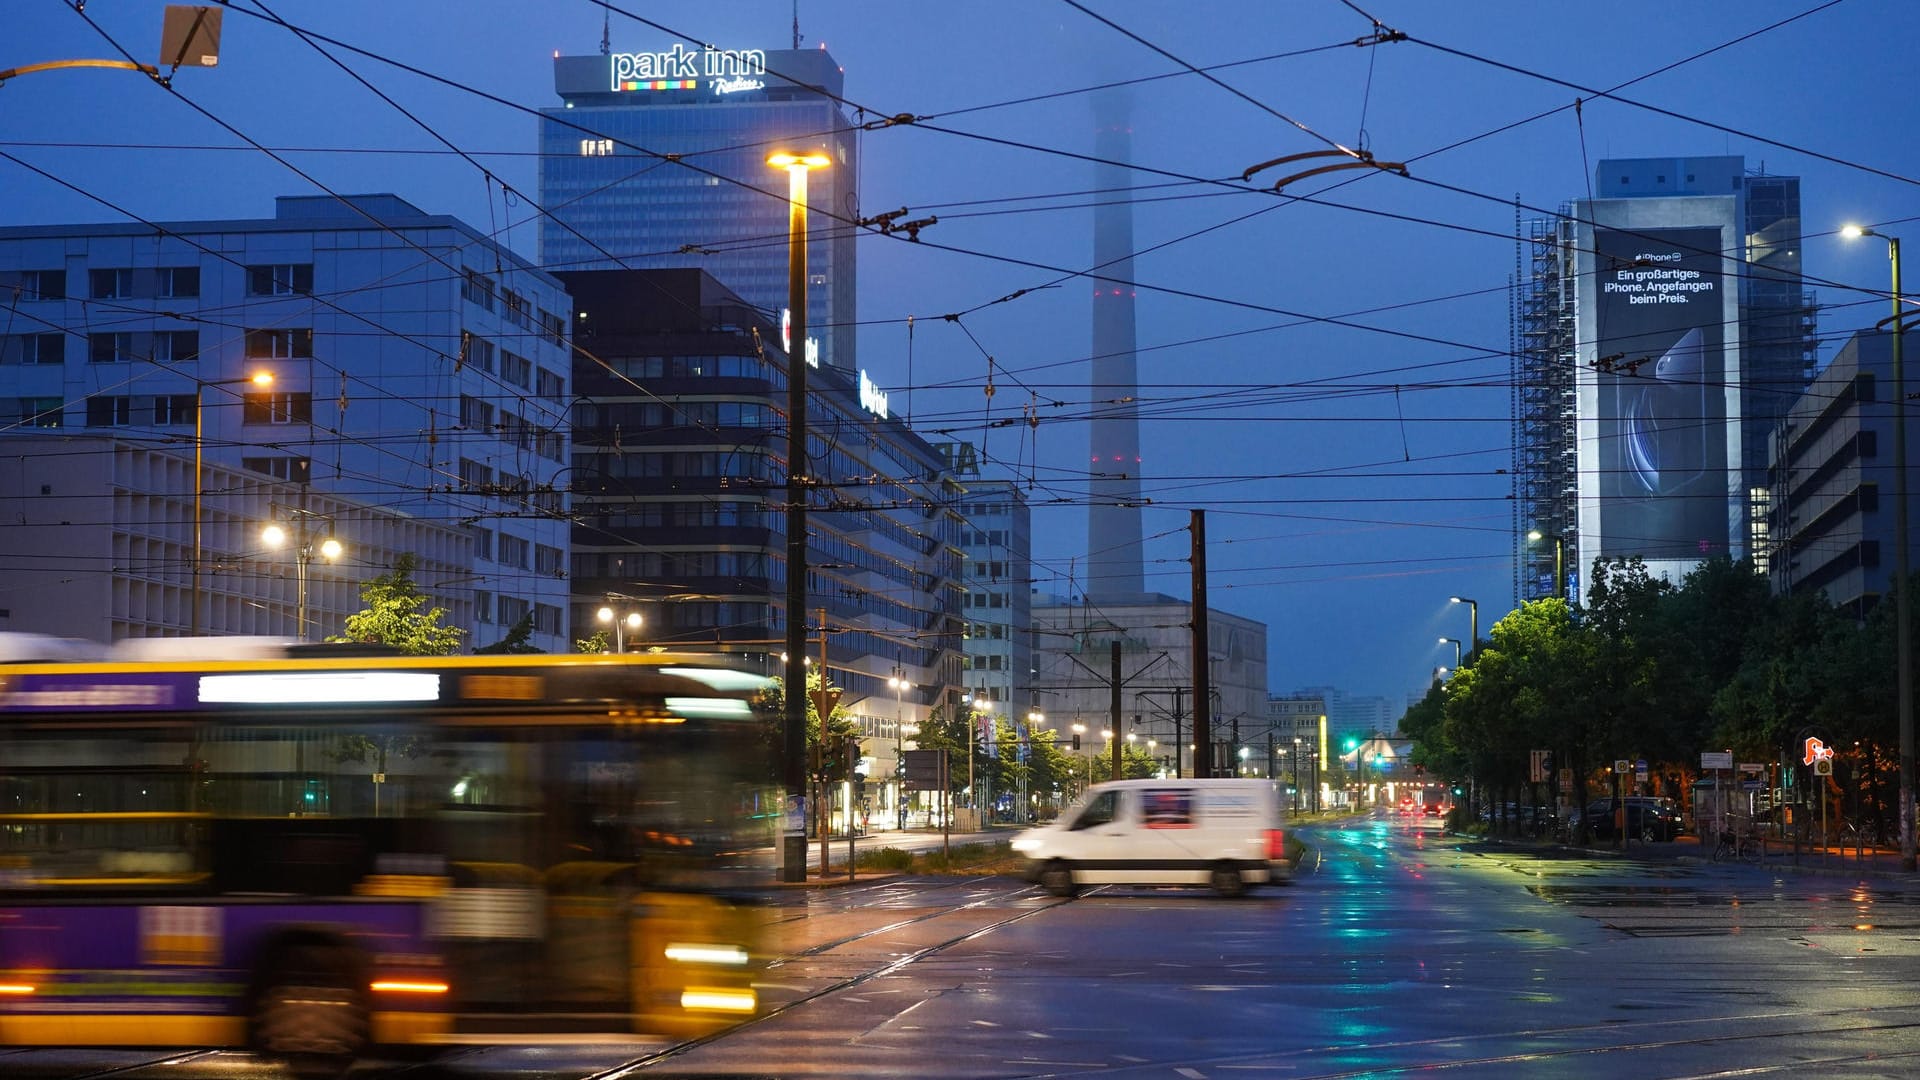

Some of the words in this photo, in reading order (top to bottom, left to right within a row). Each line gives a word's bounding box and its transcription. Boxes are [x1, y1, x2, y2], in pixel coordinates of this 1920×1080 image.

[611, 43, 698, 92] park
[705, 43, 766, 76] inn
[1642, 253, 1672, 262] iPhone
[1617, 270, 1634, 281] Ein
[1636, 268, 1700, 282] großartiges
[1604, 282, 1645, 293] iPhone.
[1646, 281, 1713, 293] Angefangen
[1630, 294, 1657, 304] beim
[1659, 293, 1689, 304] Preis.
